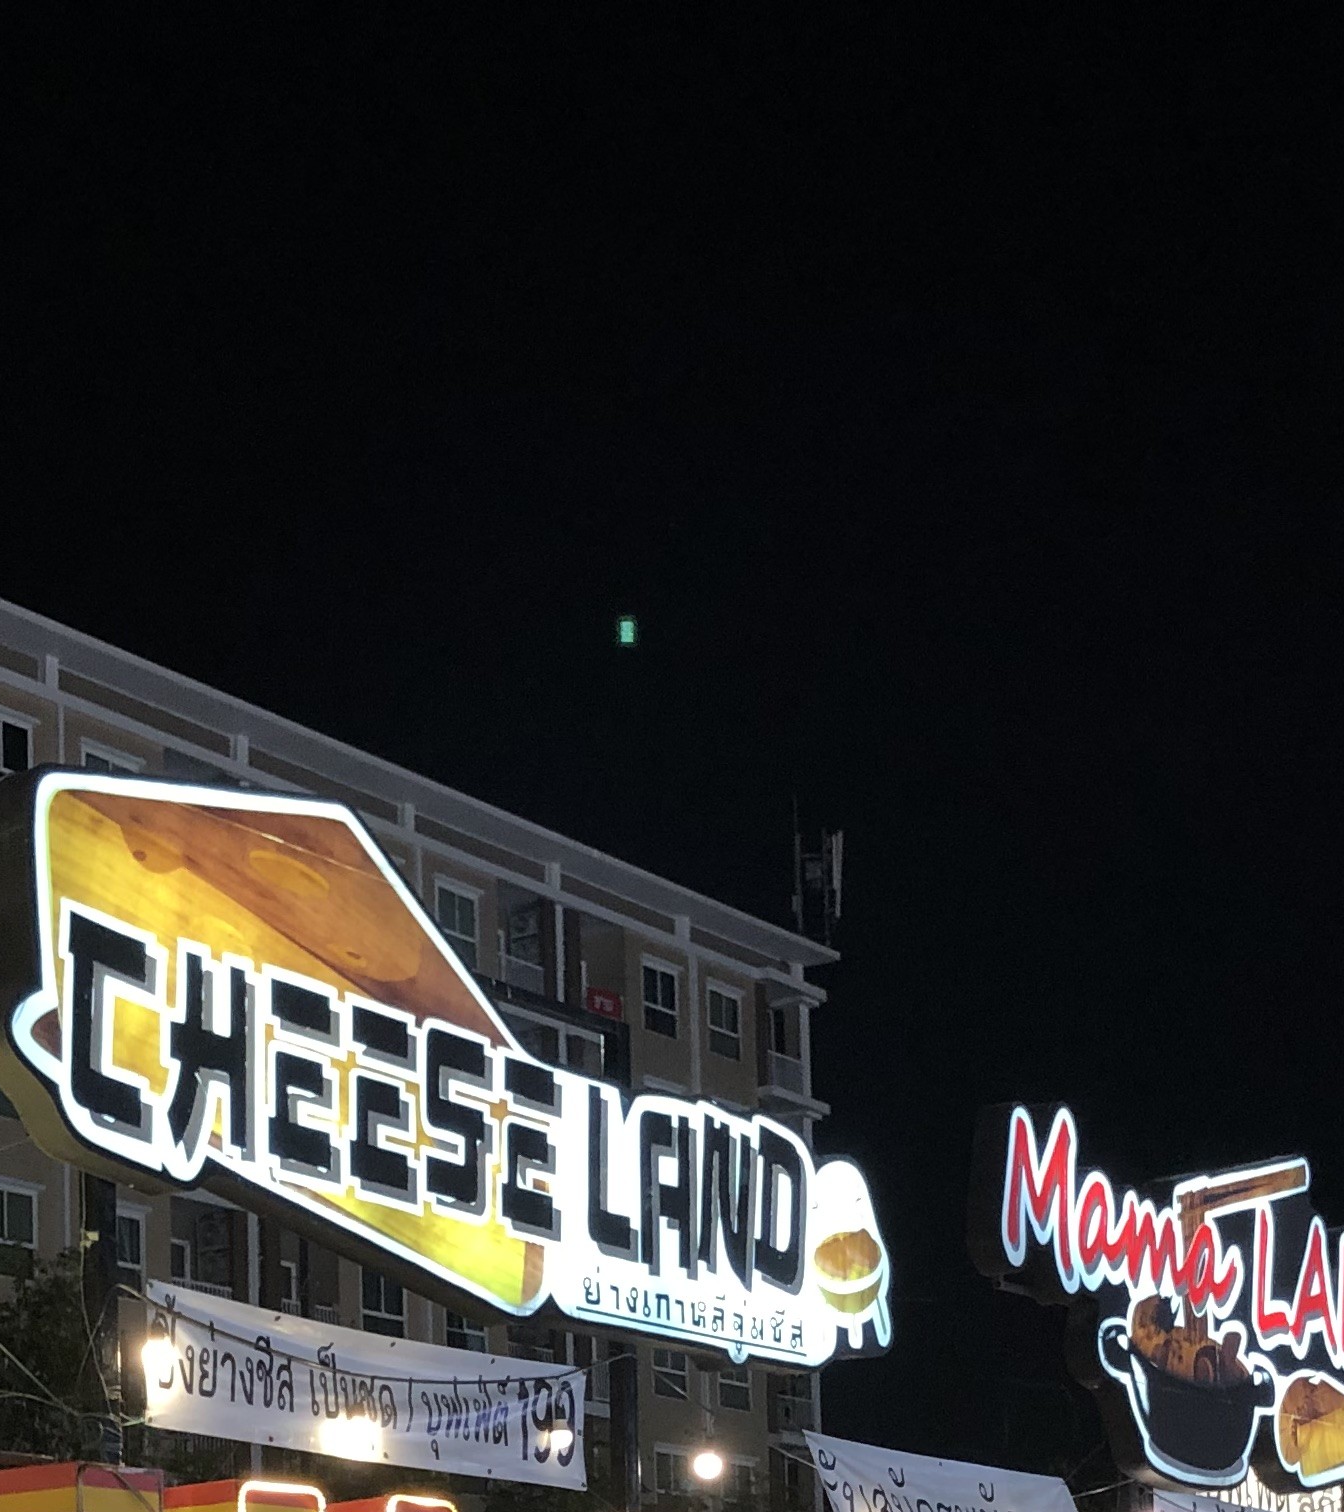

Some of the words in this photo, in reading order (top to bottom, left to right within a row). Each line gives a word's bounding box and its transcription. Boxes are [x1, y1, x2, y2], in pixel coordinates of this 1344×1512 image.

[67, 912, 560, 1242] CHEESE
[587, 1088, 809, 1294] LAND
[1004, 1112, 1238, 1312] Mama
